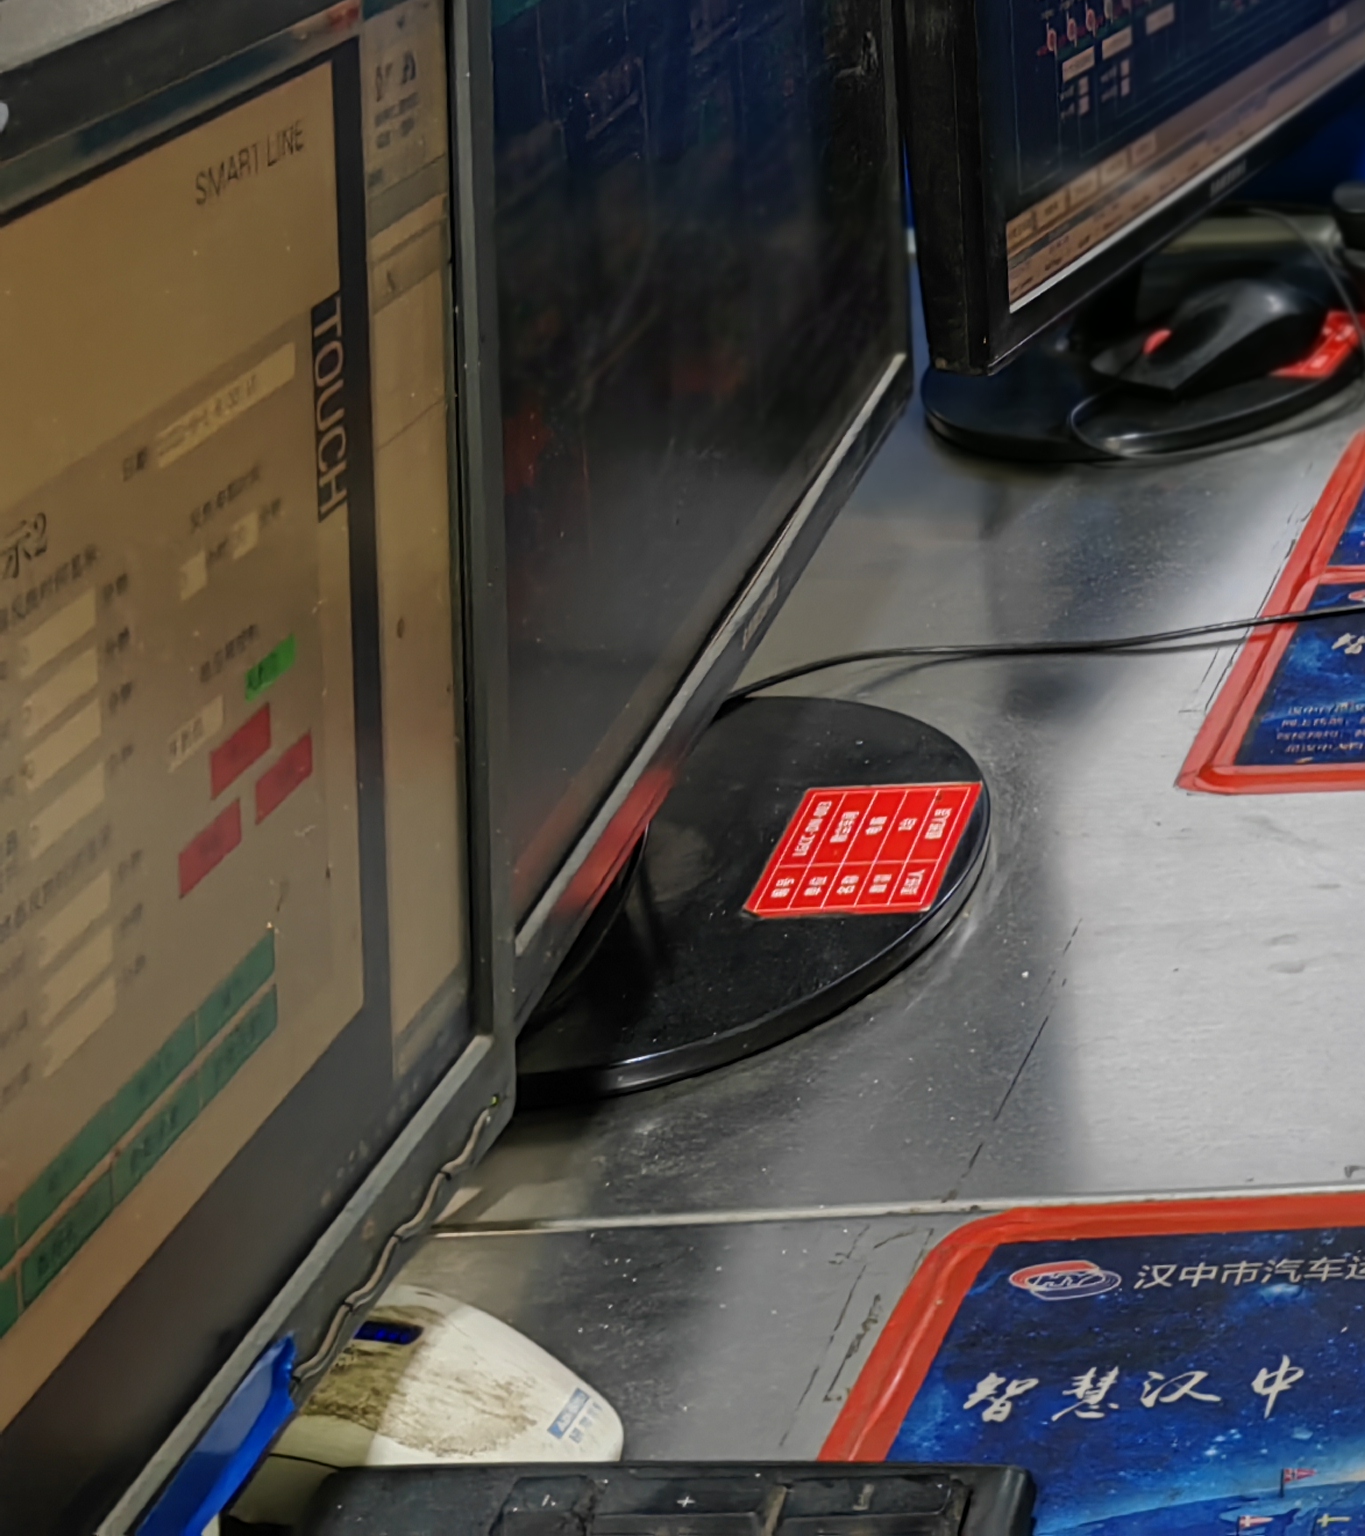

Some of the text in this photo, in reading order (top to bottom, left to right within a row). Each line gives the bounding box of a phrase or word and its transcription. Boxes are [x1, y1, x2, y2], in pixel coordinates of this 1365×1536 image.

[195, 118, 304, 206] SMART LINE
[314, 295, 348, 515] TOUCH
[961, 1352, 1307, 1424] 智慧汉中
